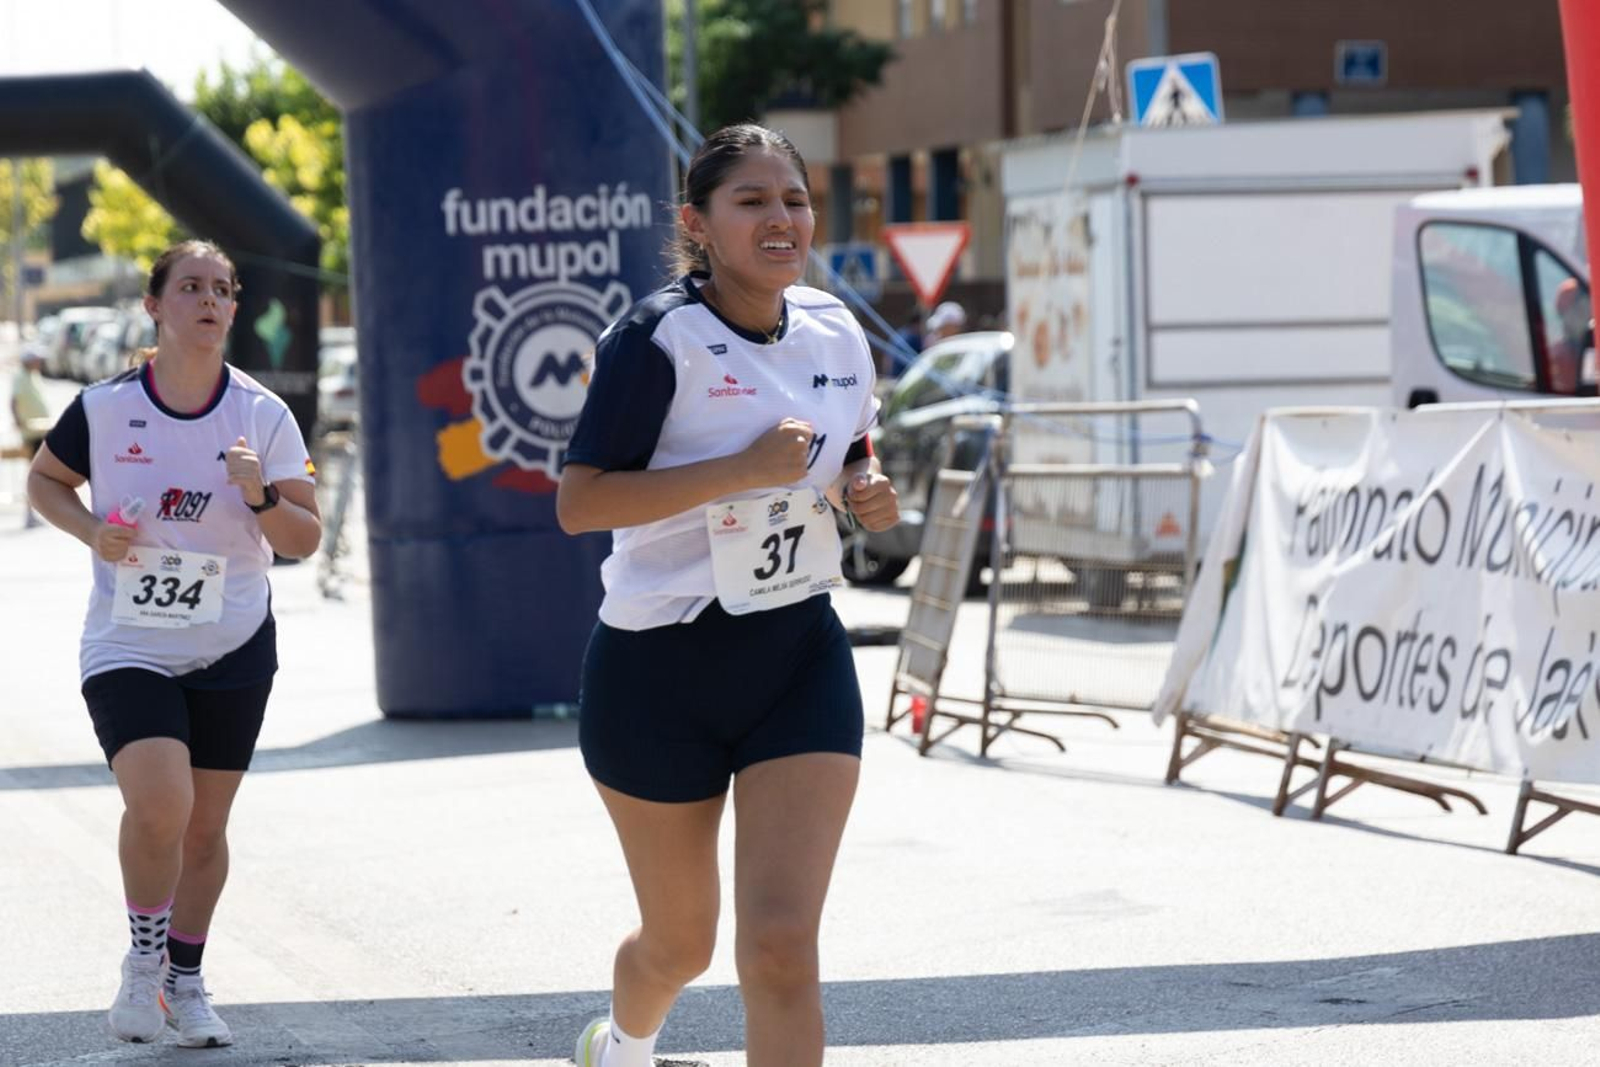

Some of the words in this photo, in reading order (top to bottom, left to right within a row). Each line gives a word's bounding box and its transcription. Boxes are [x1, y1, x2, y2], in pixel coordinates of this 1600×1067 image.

[441, 182, 652, 236] fundación
[482, 229, 620, 284] mupol
[114, 454, 154, 465] Santander
[753, 524, 805, 580] 37
[132, 574, 205, 610] 334
